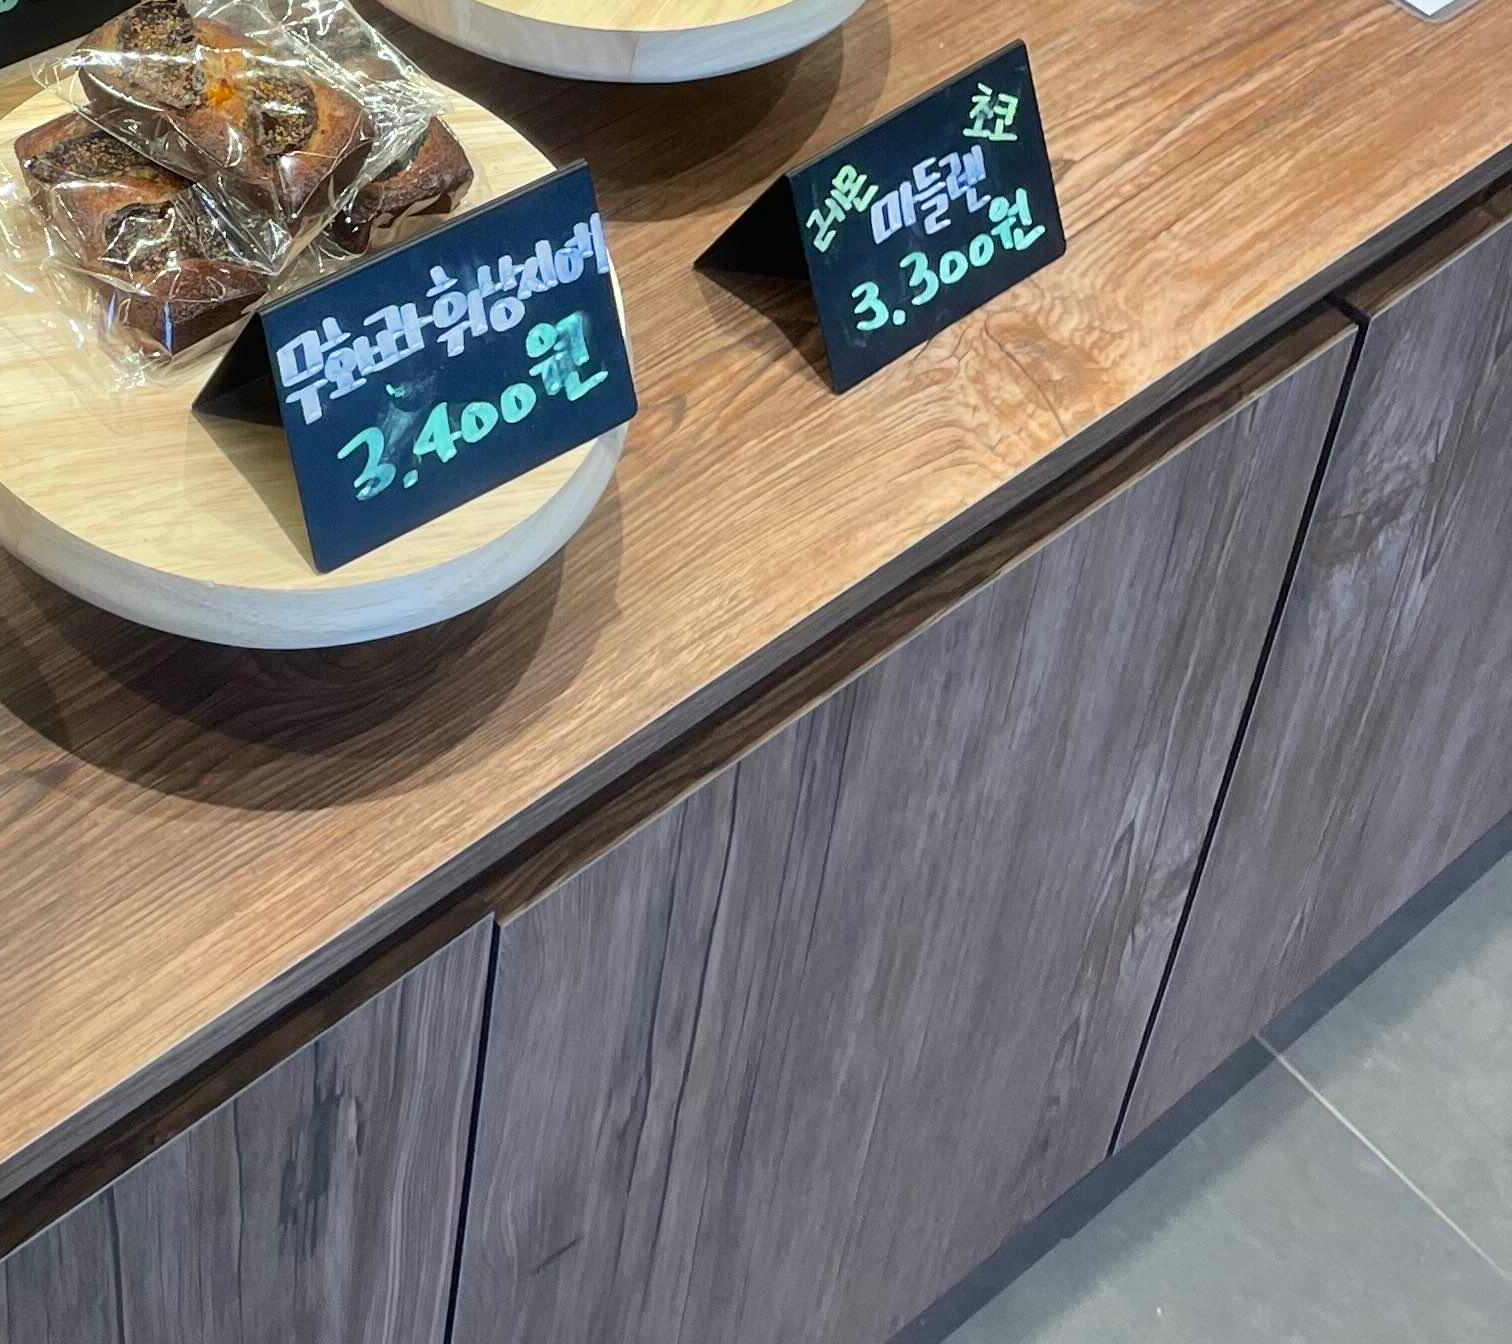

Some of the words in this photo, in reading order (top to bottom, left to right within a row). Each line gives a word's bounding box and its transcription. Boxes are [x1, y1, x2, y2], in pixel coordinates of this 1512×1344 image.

[963, 82, 1019, 141] 초코
[806, 164, 879, 253] 레몬
[869, 144, 991, 245] 마들렌
[851, 188, 1046, 331] 3.300원
[337, 311, 609, 501] 3.400원
